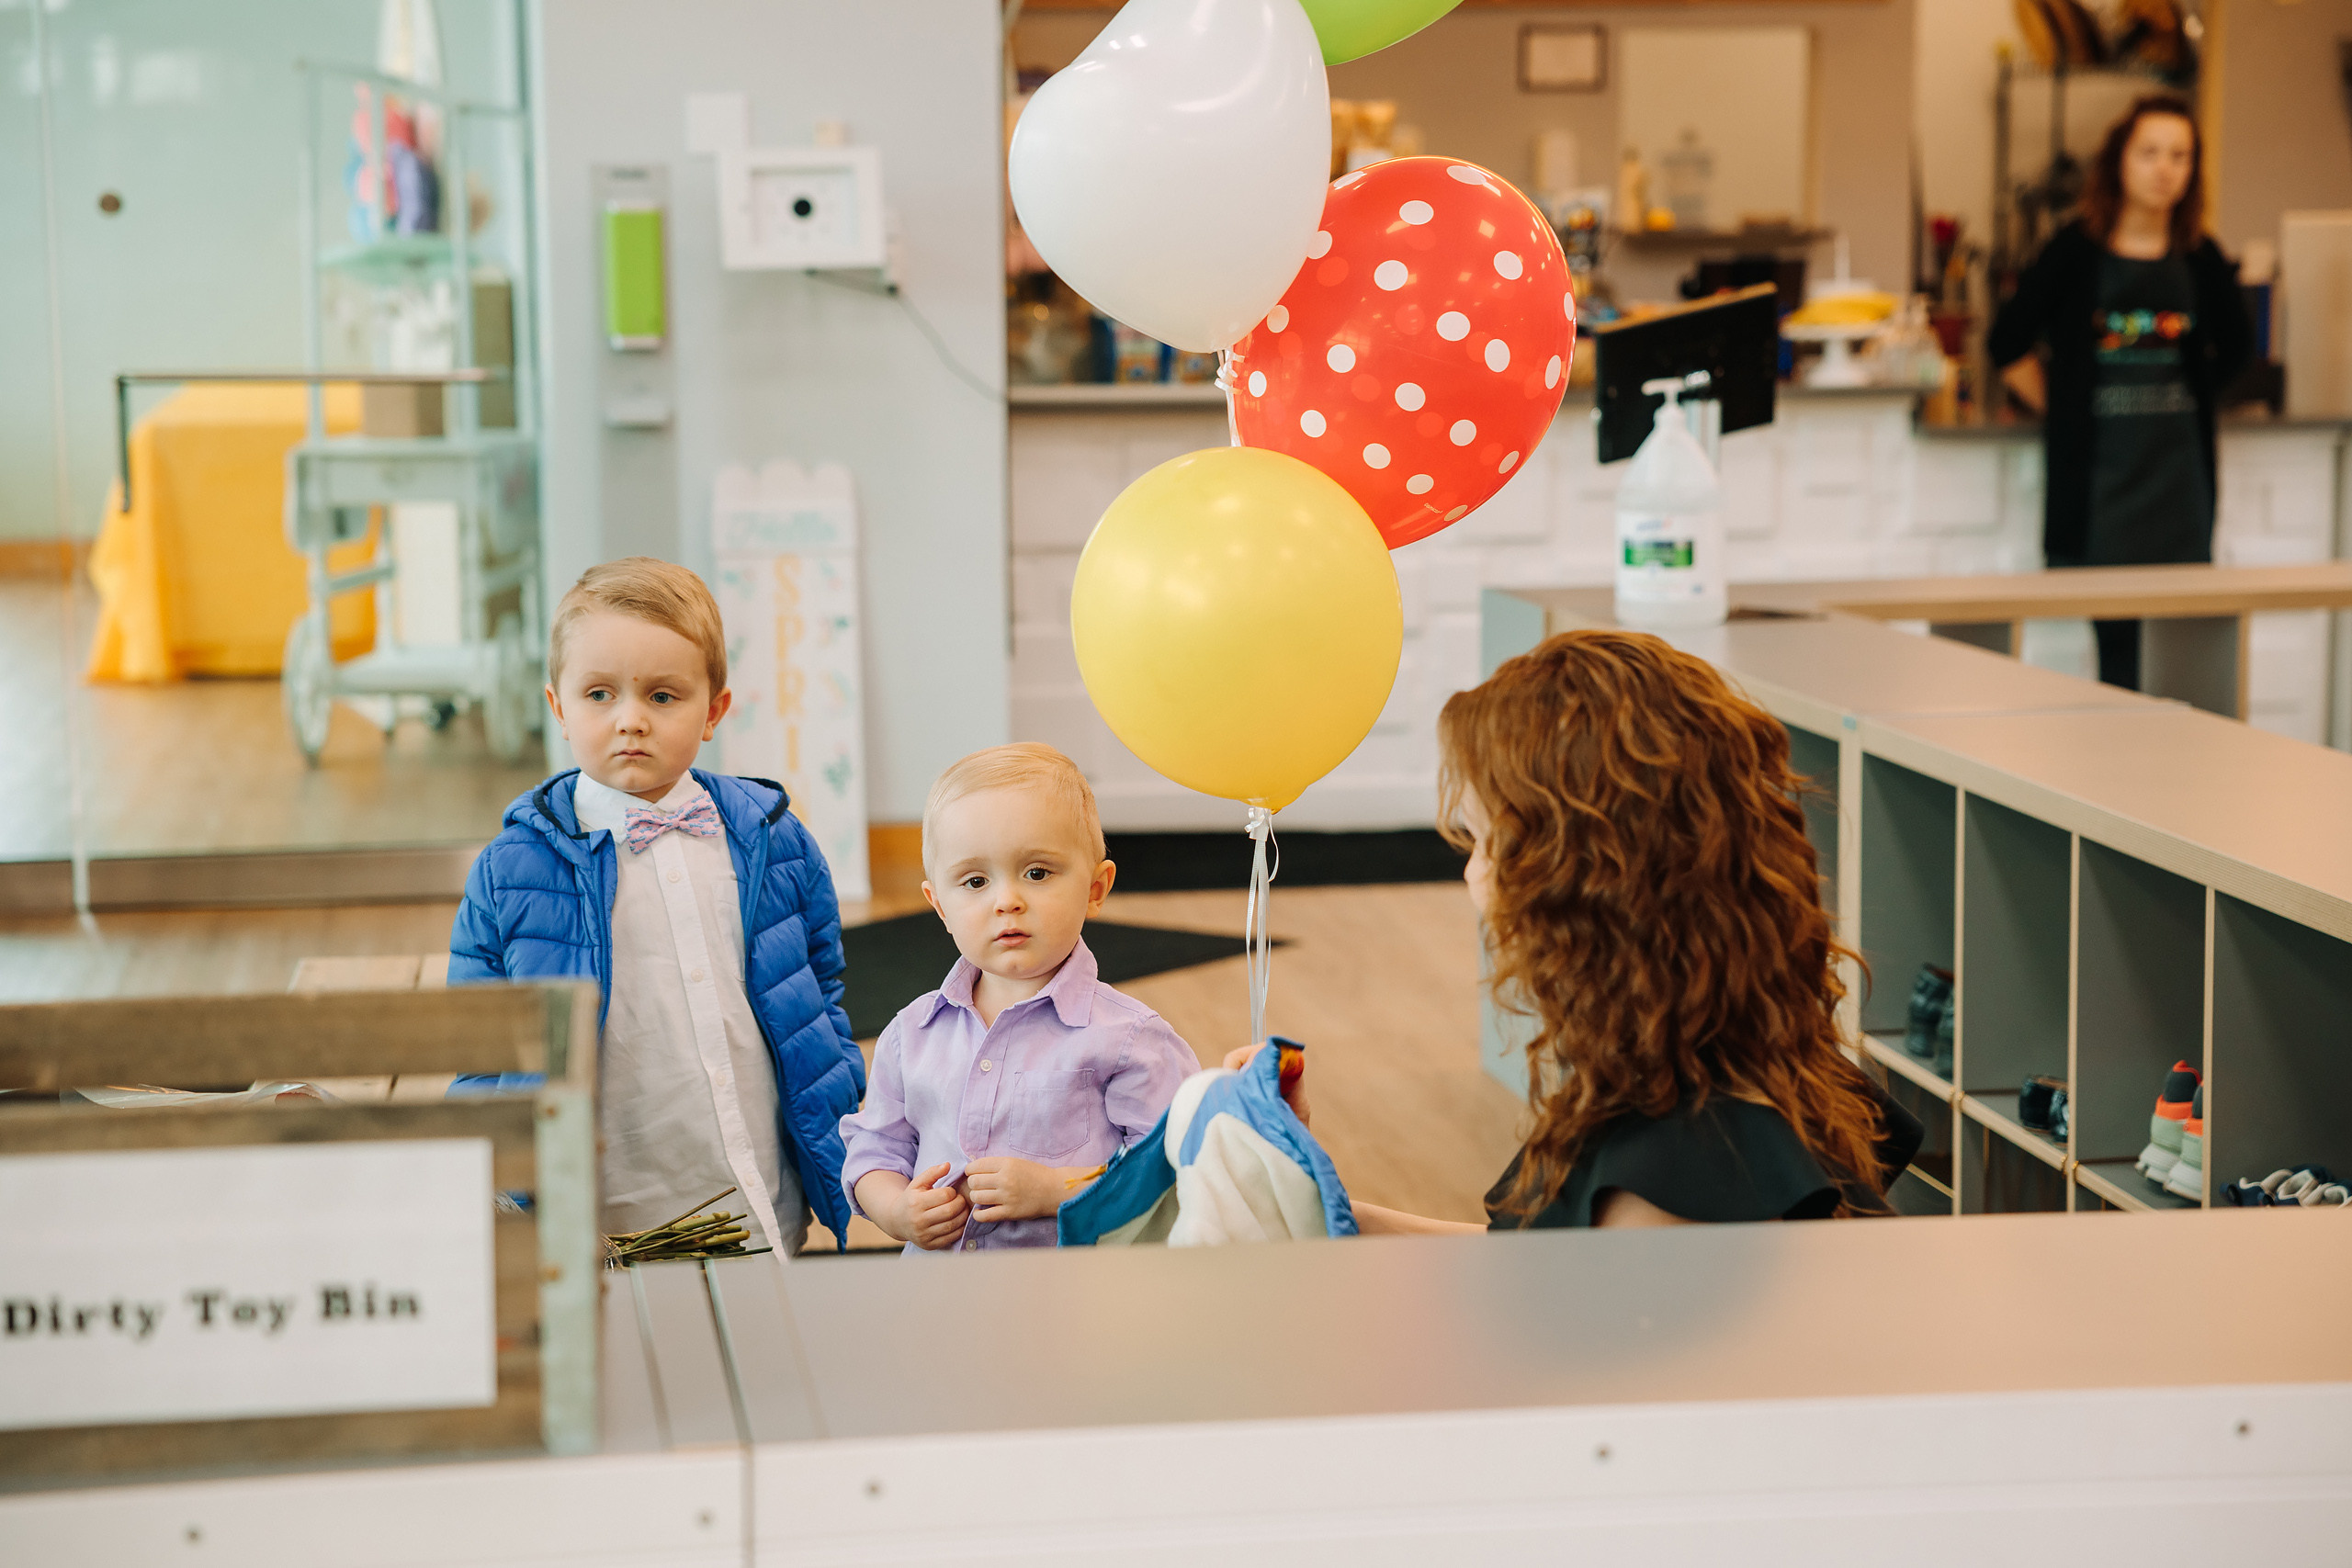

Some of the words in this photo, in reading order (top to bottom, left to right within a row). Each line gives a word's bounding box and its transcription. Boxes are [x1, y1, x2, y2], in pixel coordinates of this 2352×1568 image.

[3, 1297, 164, 1343] Dirty
[184, 1288, 294, 1337] Toy
[319, 1283, 421, 1323] Bin
